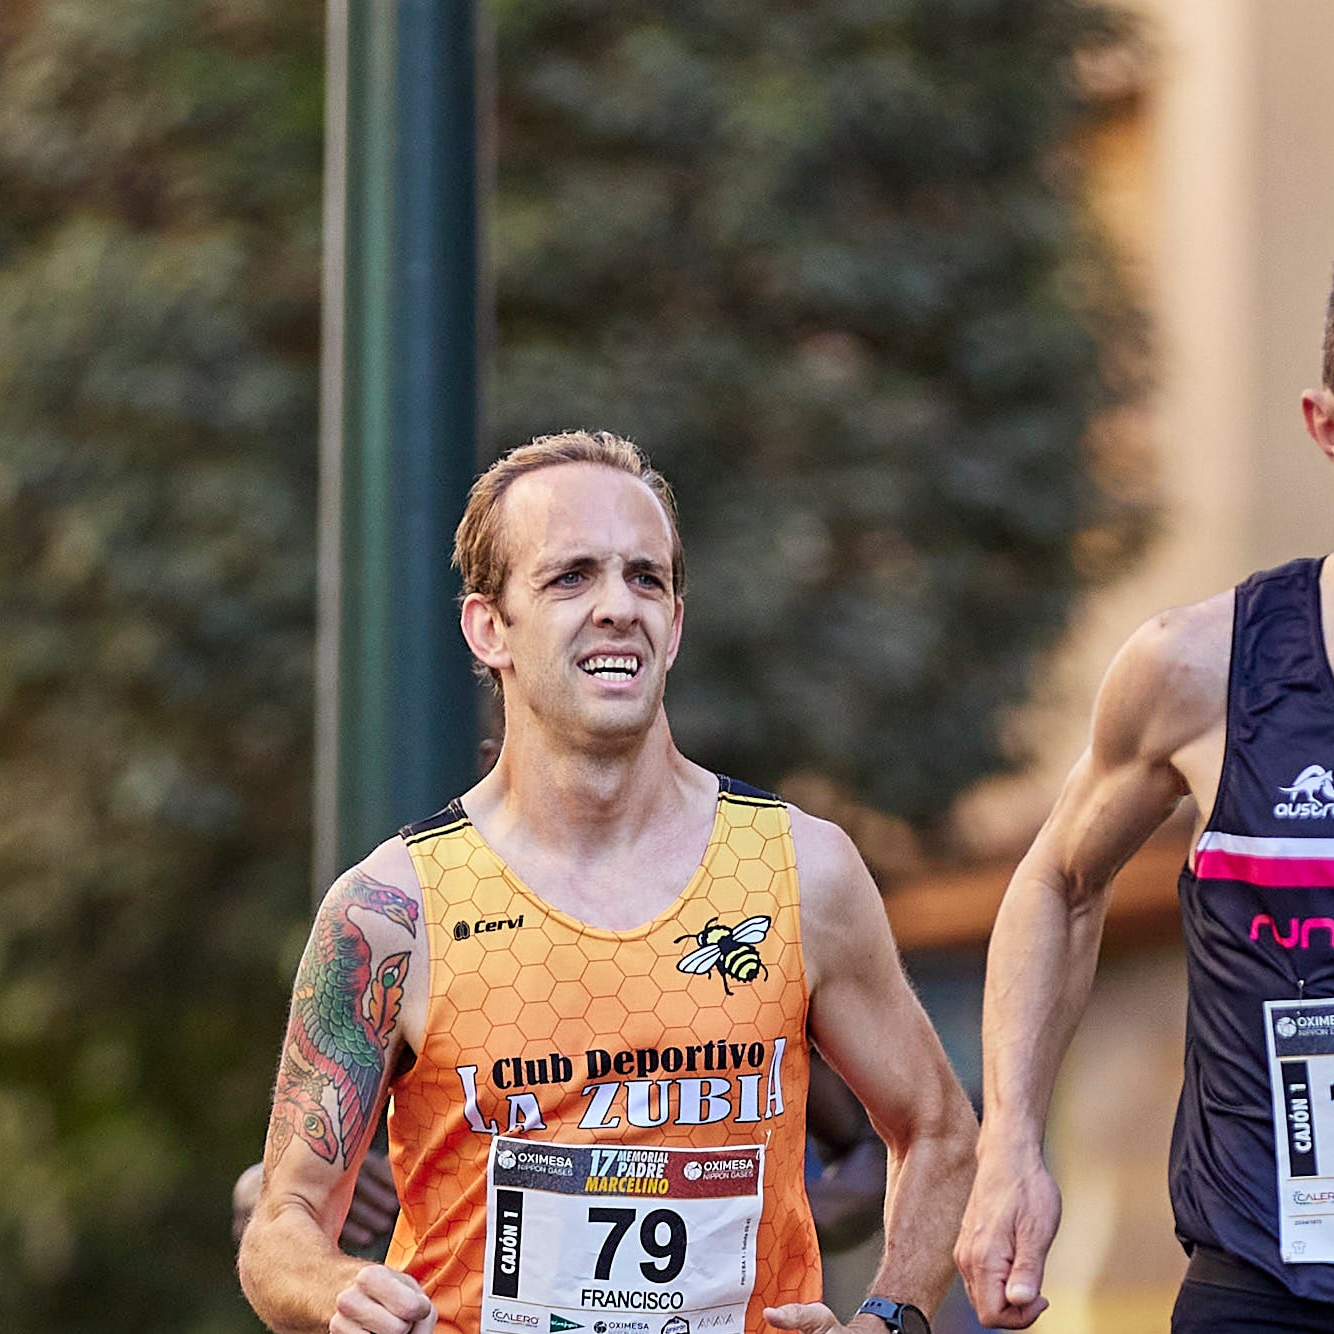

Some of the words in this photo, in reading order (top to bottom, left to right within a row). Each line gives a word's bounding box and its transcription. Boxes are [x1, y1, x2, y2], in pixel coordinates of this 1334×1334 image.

[474, 915, 524, 935] Cervi
[492, 1053, 573, 1090] Club
[586, 1038, 765, 1080] Deportivo
[456, 1065, 547, 1136] LA
[578, 1037, 787, 1130] ZUBIA
[1289, 1083, 1307, 1093] 1
[1288, 1098, 1312, 1154] CAJÓN
[517, 1152, 573, 1169] OXIMESA
[589, 1149, 619, 1177] 17
[617, 1150, 670, 1164] MEMORIAL
[616, 1161, 665, 1179] PADRE
[703, 1158, 754, 1172] OXIMESA
[584, 1176, 670, 1195] MARCELINO
[503, 1210, 519, 1218] 1
[498, 1224, 518, 1275] CAJÓN
[588, 1207, 688, 1284] 79
[580, 1288, 684, 1310] FRANCISCO
[495, 1310, 539, 1325] CALERO
[608, 1321, 650, 1330] OXIMESA
[698, 1313, 735, 1329] ANAYA
